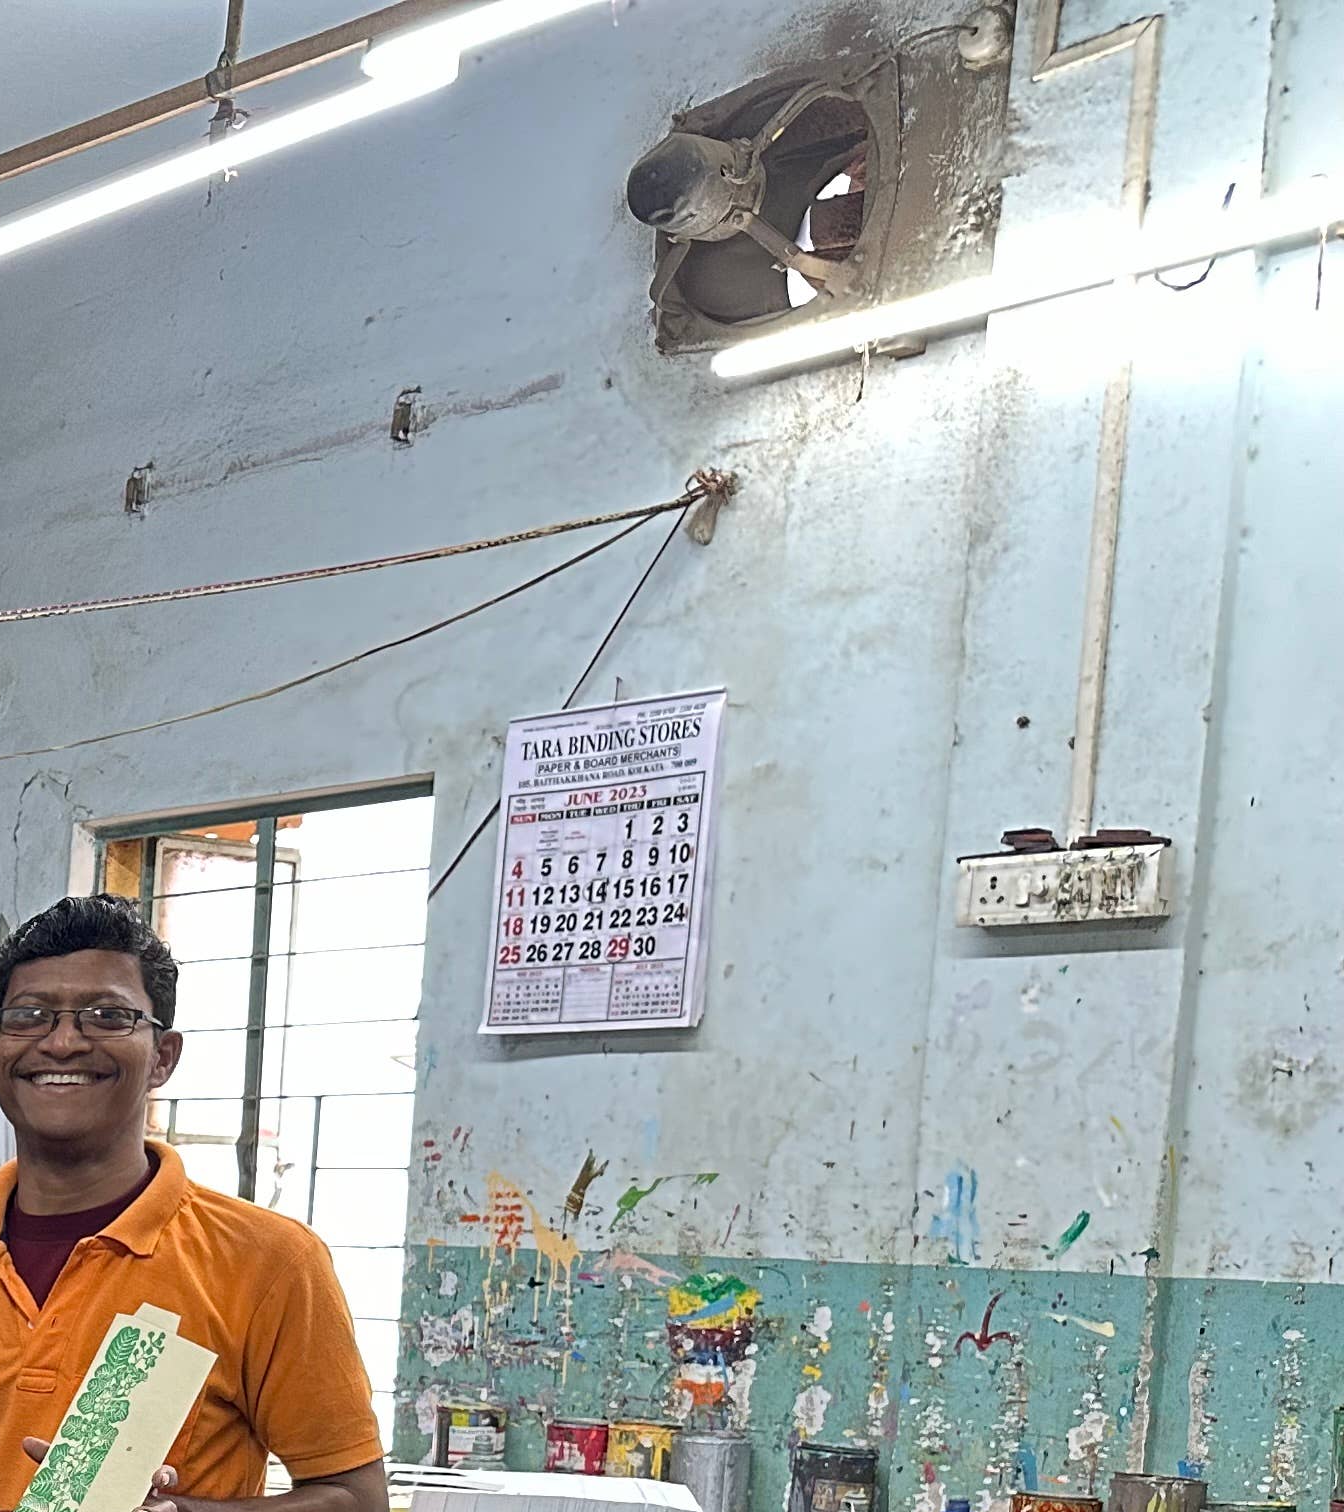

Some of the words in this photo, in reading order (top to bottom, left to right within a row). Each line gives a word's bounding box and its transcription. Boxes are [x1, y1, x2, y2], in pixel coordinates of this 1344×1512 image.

[521, 738, 563, 760] TARA
[568, 727, 635, 755] BINDING
[638, 717, 702, 747] STORES
[537, 761, 571, 774] PAPER
[573, 760, 581, 770] &
[583, 756, 618, 769] BOARD
[620, 745, 679, 764] MERCHANTS
[513, 815, 534, 823] SUN
[540, 812, 562, 821] MON
[569, 809, 587, 818] TUE
[594, 806, 617, 815] WED
[623, 802, 642, 811] THU
[652, 799, 667, 808] FRI
[675, 796, 694, 804] SAT
[564, 790, 602, 807] JUNE
[608, 785, 648, 801] 2023
[624, 819, 633, 839] 1
[652, 815, 664, 836] 2
[677, 813, 689, 832] 3
[511, 860, 523, 879] 4
[541, 858, 552, 877] 5
[568, 855, 579, 875] 6
[596, 853, 607, 872] 7
[621, 849, 633, 869] 8
[648, 846, 660, 866] 9
[669, 843, 691, 864] 10
[505, 888, 525, 907] 11
[532, 886, 554, 906] 12
[559, 884, 580, 904] 13
[587, 881, 607, 901] 14
[613, 879, 634, 899] 15
[640, 876, 661, 897] 16
[667, 874, 689, 894] 17
[503, 917, 523, 937] 18
[530, 915, 551, 934] 19
[554, 913, 577, 932] 20
[583, 910, 604, 930] 21
[609, 908, 631, 929] 22
[636, 906, 658, 926] 23
[662, 903, 685, 923] 24
[499, 945, 521, 964] 25
[526, 943, 548, 962] 26
[552, 942, 574, 961] 27
[579, 940, 601, 959] 28
[607, 938, 630, 957] 29
[633, 936, 656, 956] 30
